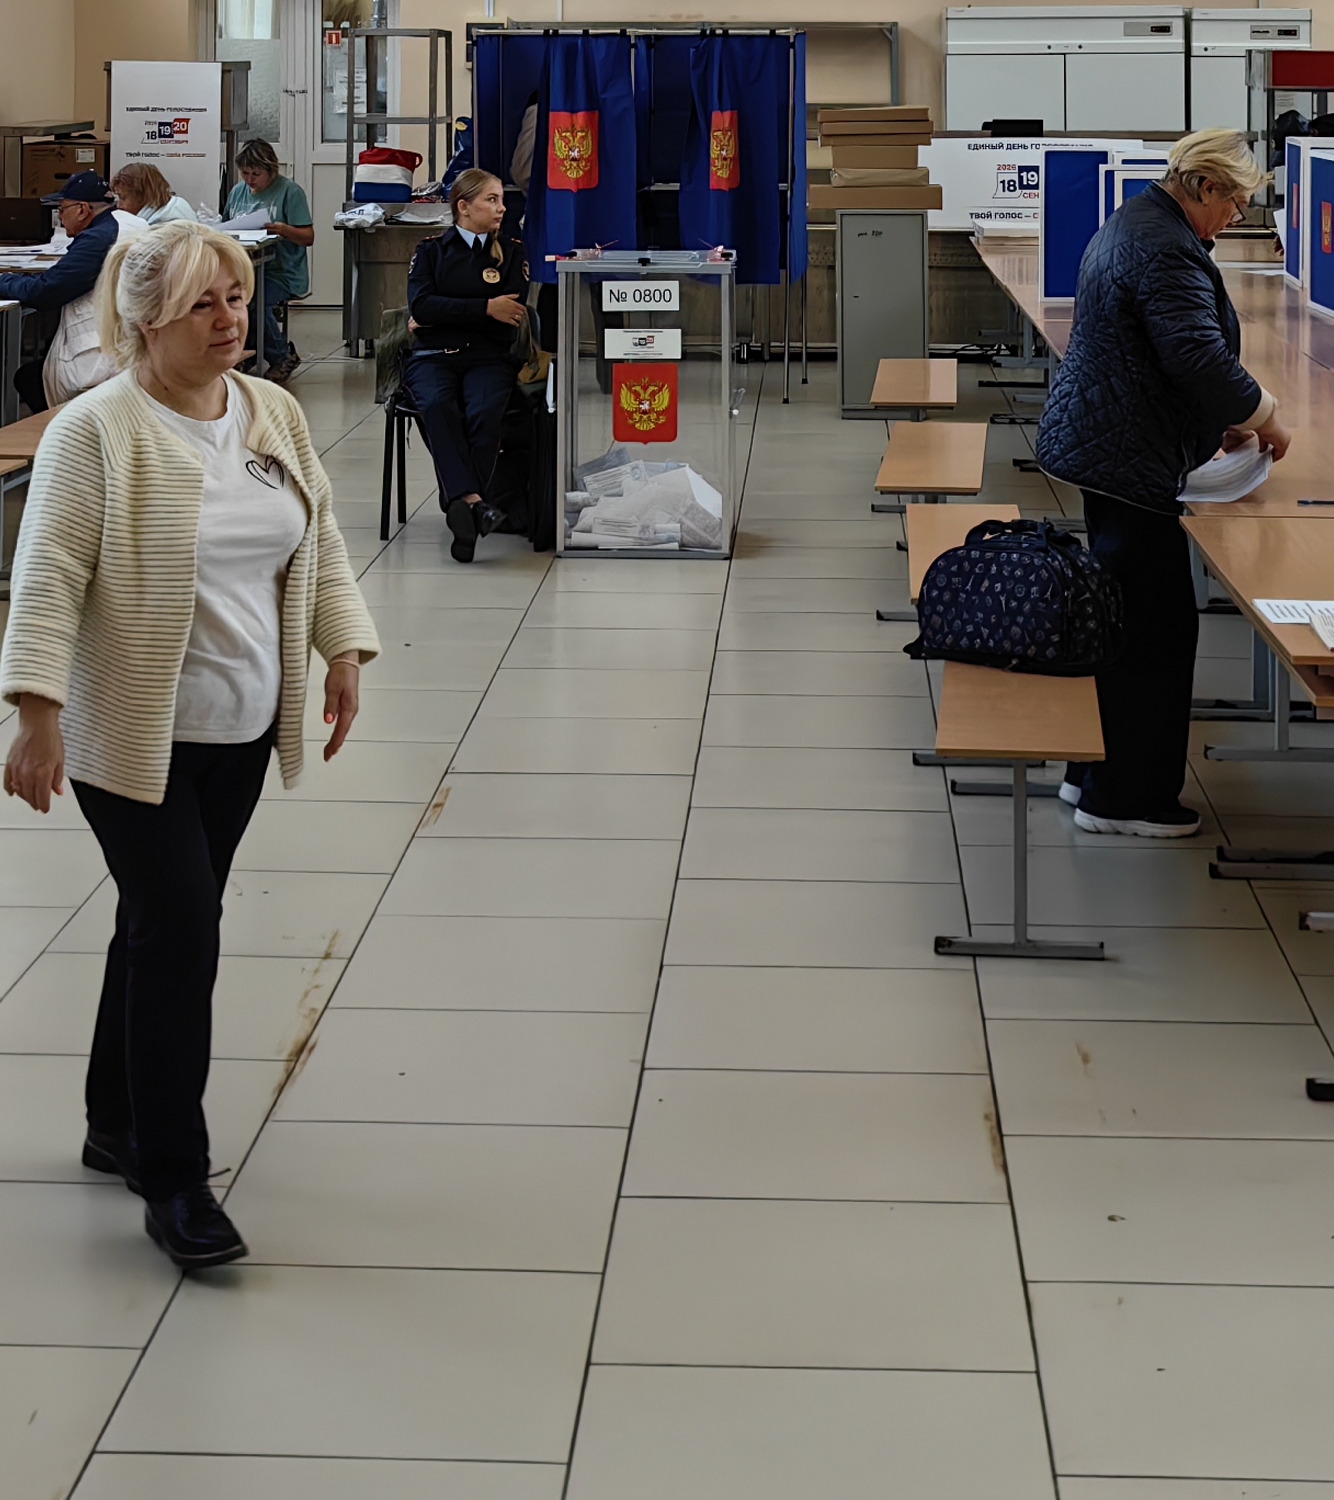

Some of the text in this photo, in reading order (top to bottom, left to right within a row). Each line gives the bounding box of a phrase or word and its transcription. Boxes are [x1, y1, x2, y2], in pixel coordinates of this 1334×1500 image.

[159, 126, 171, 135] 19
[173, 121, 187, 131] 20
[145, 131, 157, 140] 18
[967, 143, 1004, 151] ЕДИНЫЙ
[1005, 143, 1029, 151] ДЕНЬ
[1020, 171, 1038, 185] 19
[999, 179, 1017, 193] 18
[1022, 191, 1039, 199] СЕН
[969, 211, 993, 220] ТВОЙ
[994, 212, 1023, 220] ГОЛОС
[609, 288, 672, 303] № 0800
